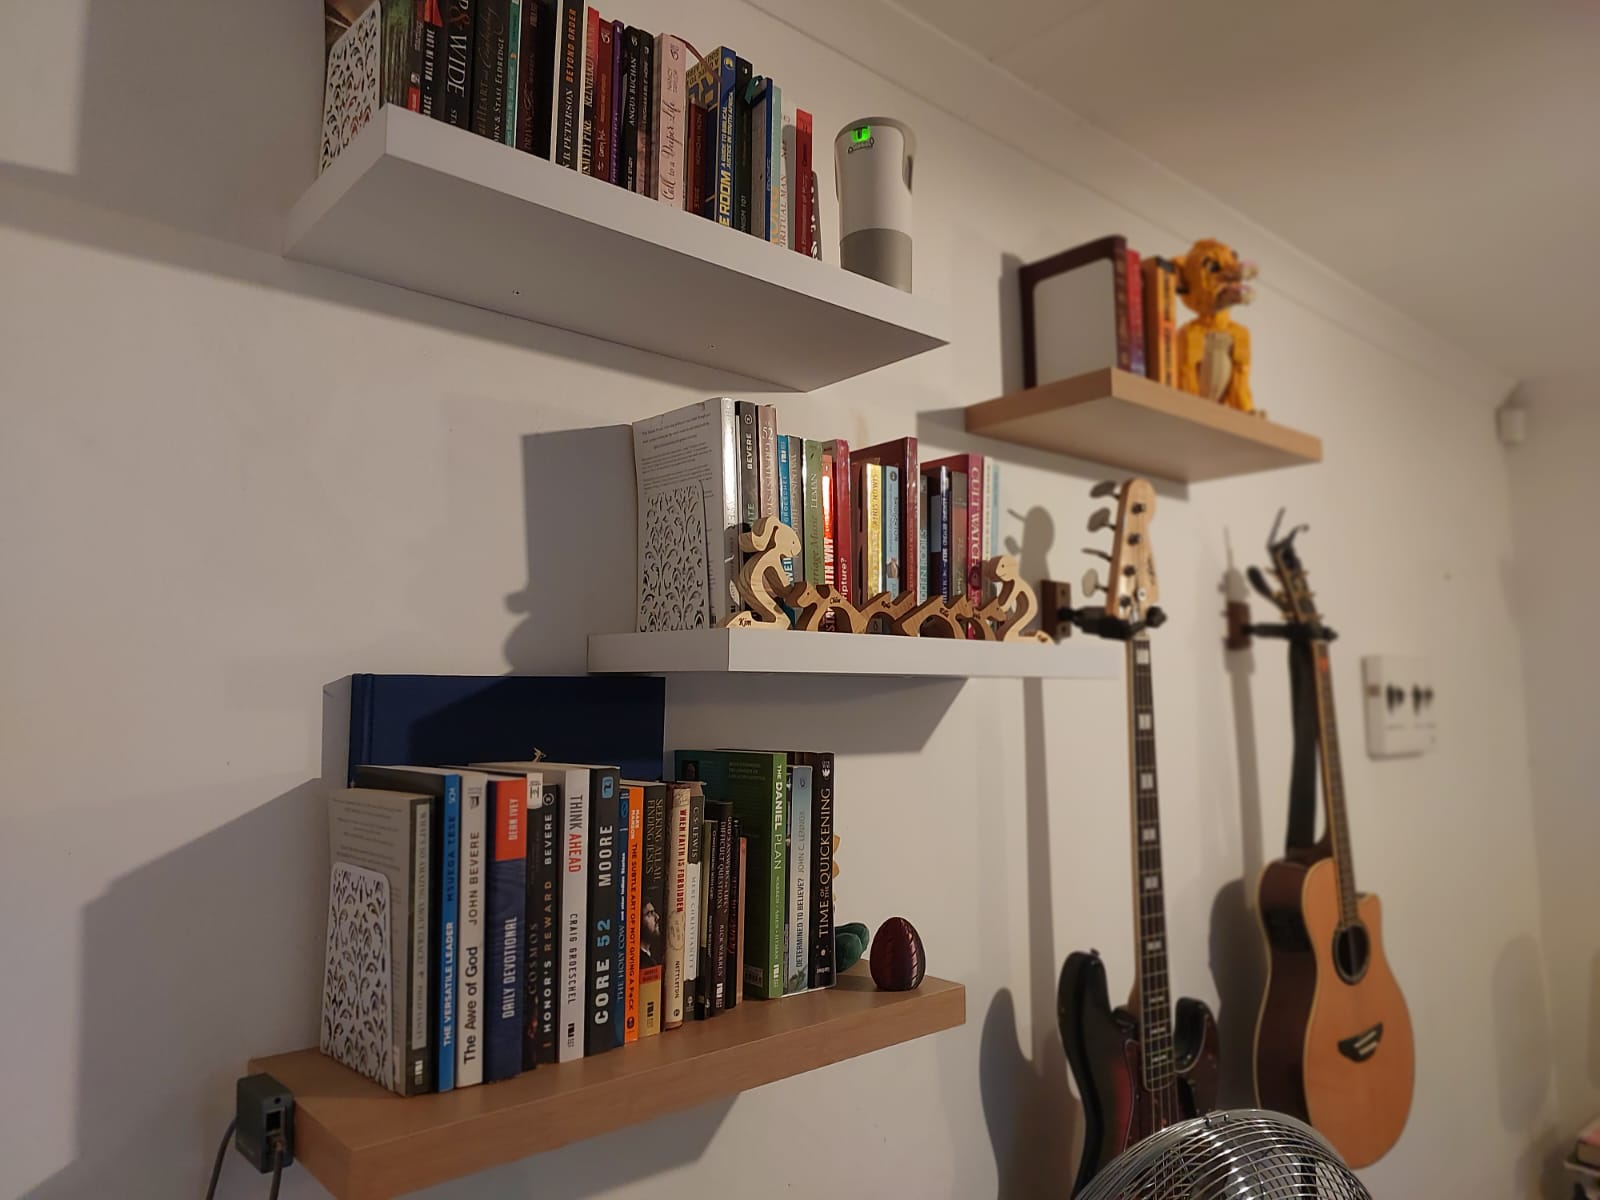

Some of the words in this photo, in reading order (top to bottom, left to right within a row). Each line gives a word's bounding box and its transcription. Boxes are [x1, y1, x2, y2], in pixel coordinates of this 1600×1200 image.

[426, 28, 436, 48] LOVE
[567, 8, 577, 41] ORDER
[424, 62, 434, 81] WALK
[425, 50, 434, 60] IN
[446, 34, 467, 98] WIDE
[565, 43, 575, 83] BEYOND
[629, 57, 637, 93] BUCHAN
[563, 88, 574, 151] PETERSON
[628, 96, 636, 126] ANGUS
[662, 100, 681, 125] Life
[660, 175, 676, 200] Call
[719, 170, 731, 215] ROOM
[762, 426, 773, 441] 52
[745, 433, 753, 470] BEVERE
[810, 473, 818, 509] LEMAN
[972, 466, 981, 509] CULT
[823, 537, 835, 562] WHY
[971, 512, 980, 567] WATCH
[738, 618, 751, 627] Kim
[508, 798, 519, 817] IVEY
[569, 795, 584, 831] THINK
[646, 798, 655, 841] FINDING
[654, 798, 663, 842] SEEKING
[678, 809, 687, 832] WHEN
[774, 781, 783, 831] DANIEL
[507, 818, 519, 841] DEAN
[543, 814, 553, 865] BEVERE
[677, 834, 686, 856] FAITH
[691, 826, 700, 858] LEWIS
[819, 788, 831, 885] QUICKENING
[469, 831, 480, 884] BEVERE
[568, 833, 583, 873] AHEAD
[598, 823, 614, 887] MOORE
[630, 843, 638, 859] THE
[646, 843, 655, 875] JESUS
[677, 859, 685, 867] IS
[773, 833, 782, 870] PLAN
[797, 852, 805, 873] JOHN
[629, 860, 637, 892] SUBTLE
[676, 869, 685, 913] FORBIDDEN
[468, 889, 479, 926] JOHN
[796, 878, 805, 911] BELIEVE?
[542, 880, 553, 952] REWARD
[569, 913, 579, 943] CRAIG
[629, 912, 636, 922] OF
[796, 912, 804, 921] TO
[818, 899, 830, 938] TIME
[445, 921, 455, 964] LEADER
[502, 916, 519, 984] DEVOTIONAL
[617, 924, 626, 951] COW
[795, 922, 804, 968] DETERMINED
[465, 946, 479, 978] God
[527, 921, 540, 996] COSMOS
[617, 952, 626, 977] HOLY
[628, 946, 636, 977] GIVING
[464, 981, 478, 996] of
[567, 947, 578, 1005] GROESCHEL
[594, 958, 611, 1026] CORE
[616, 980, 625, 1002] THE
[444, 965, 453, 1023] VERSATILE
[501, 986, 516, 1019] DAILY
[542, 959, 552, 1033] HONOR'S
[464, 999, 477, 1031] Awe
[443, 1025, 453, 1047] THE
[463, 1035, 477, 1064] The
